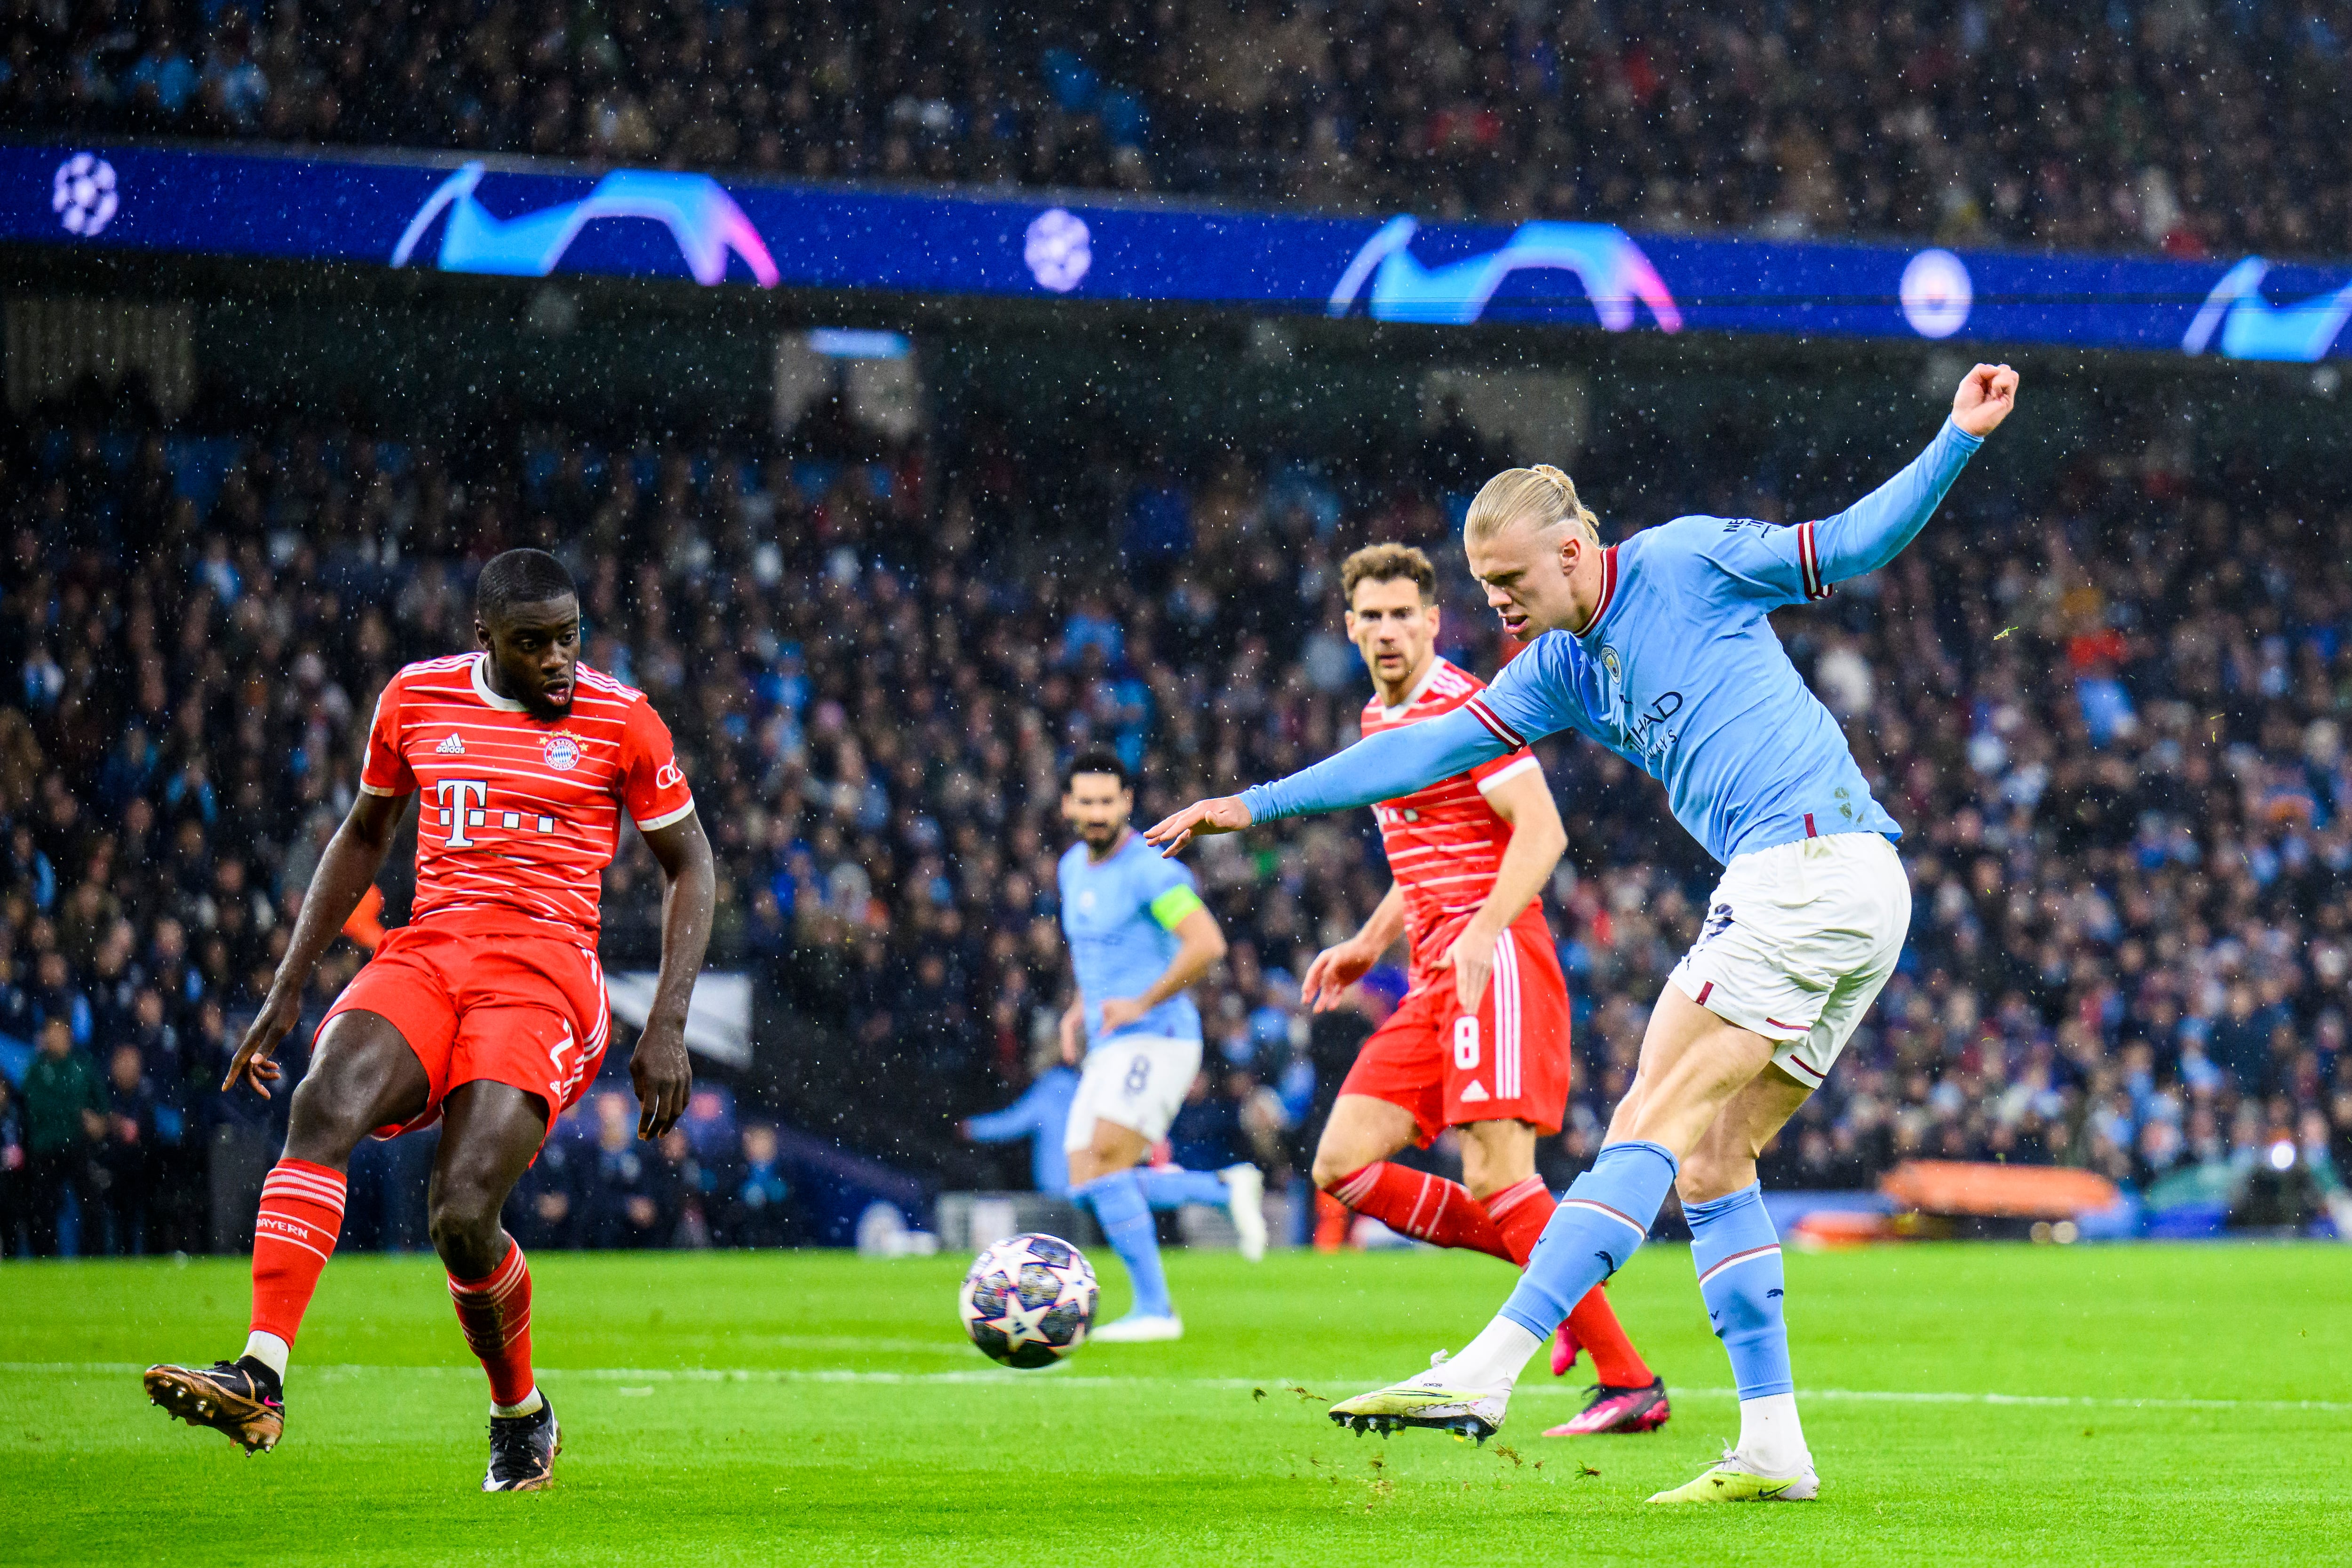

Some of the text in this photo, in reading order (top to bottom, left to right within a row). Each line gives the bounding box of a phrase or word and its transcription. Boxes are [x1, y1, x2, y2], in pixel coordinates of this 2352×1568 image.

[436, 745, 466, 754] adidas
[556, 740, 577, 755] BAYERN
[1454, 1015, 1480, 1070] 8
[1124, 1054, 1151, 1095] 8
[256, 1218, 309, 1240] BAYERN
